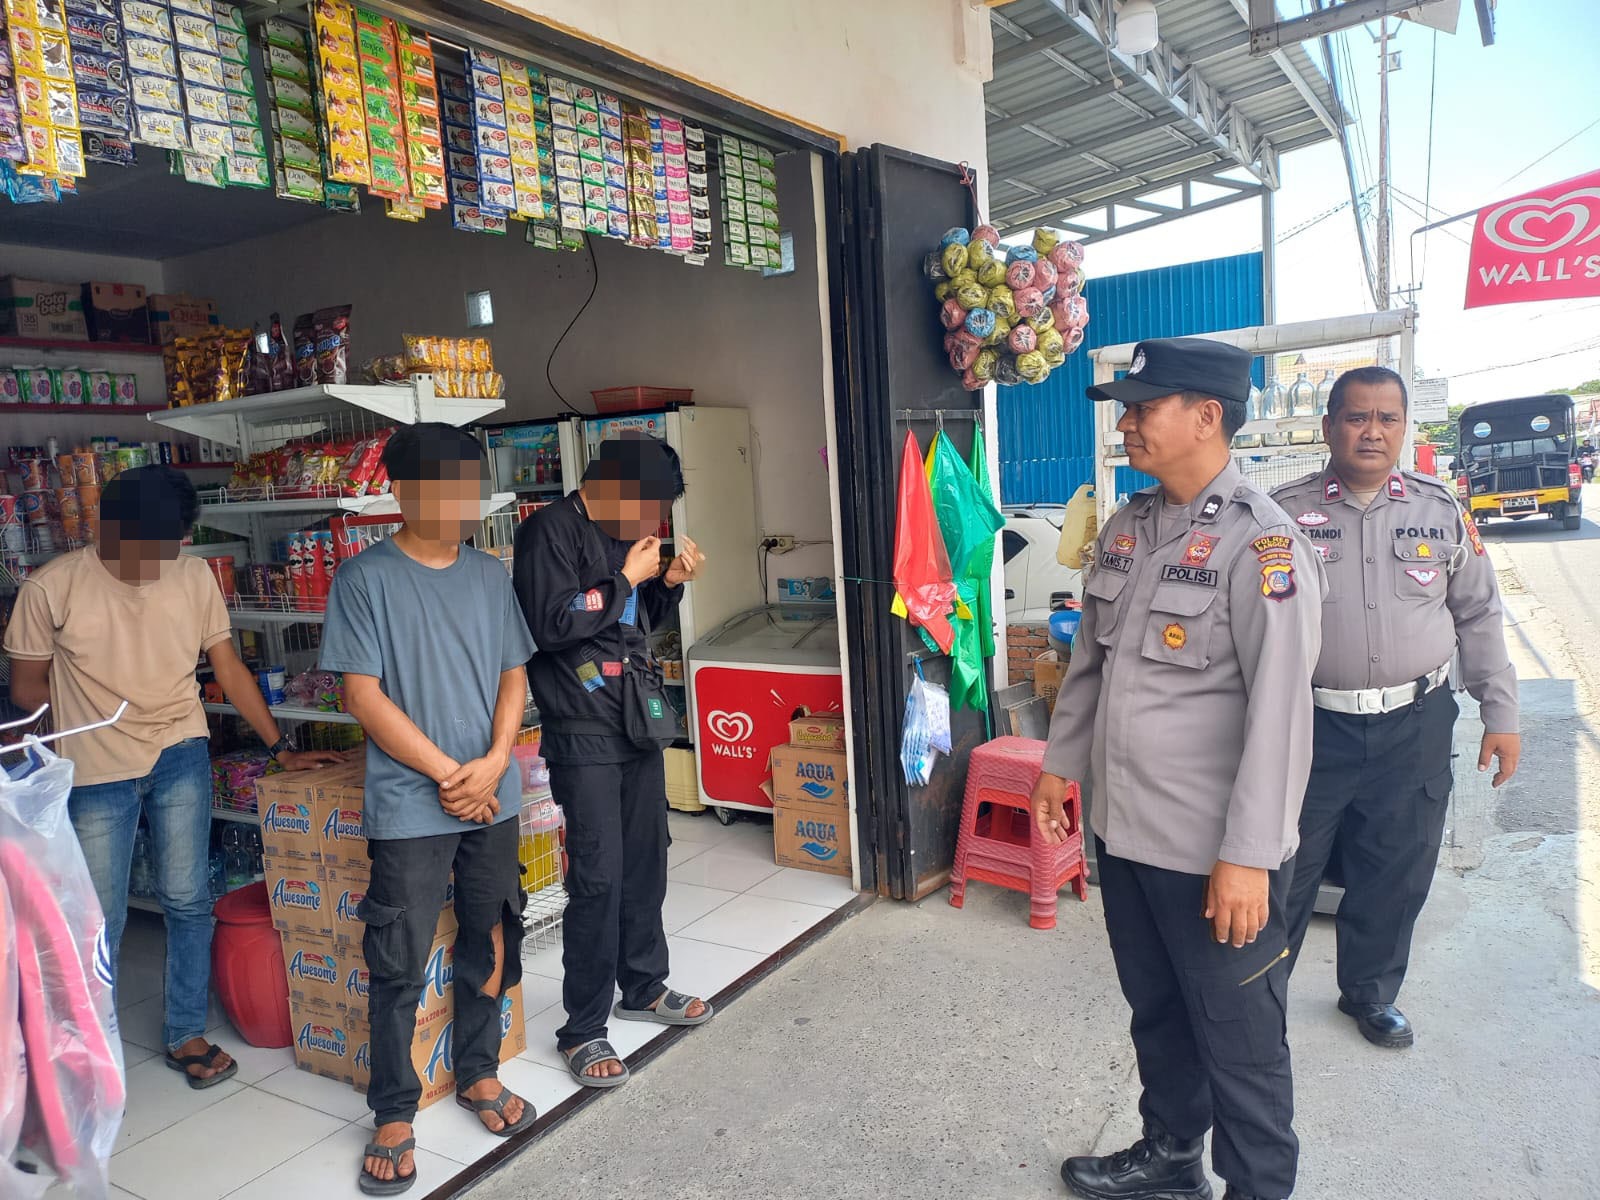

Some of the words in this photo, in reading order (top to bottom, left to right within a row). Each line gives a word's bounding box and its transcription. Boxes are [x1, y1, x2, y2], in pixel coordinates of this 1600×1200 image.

[124, 3, 153, 18] CLEAR
[176, 16, 203, 31] CLEAR
[129, 40, 159, 55] CLEAR
[74, 54, 106, 69] CLEAR
[182, 53, 208, 66] CLEAR
[134, 78, 163, 90] CLEAR
[189, 90, 214, 103] CLEAR
[141, 115, 170, 127] CLEAR
[193, 127, 218, 139] CLEAR
[228, 157, 254, 168] CLEAR
[1479, 255, 1600, 288] WALL'S
[40, 304, 65, 315] bee
[1309, 528, 1342, 540] TANDI
[1395, 527, 1445, 540] POLRI
[1166, 567, 1212, 584] POLISI
[711, 743, 753, 759] WALL'S
[795, 761, 835, 783] AQUA
[262, 802, 310, 834] Awesome
[794, 819, 838, 844] AQUA
[272, 879, 320, 910] Awesome
[289, 950, 337, 985] Awesome
[297, 1022, 346, 1057] Awesome
